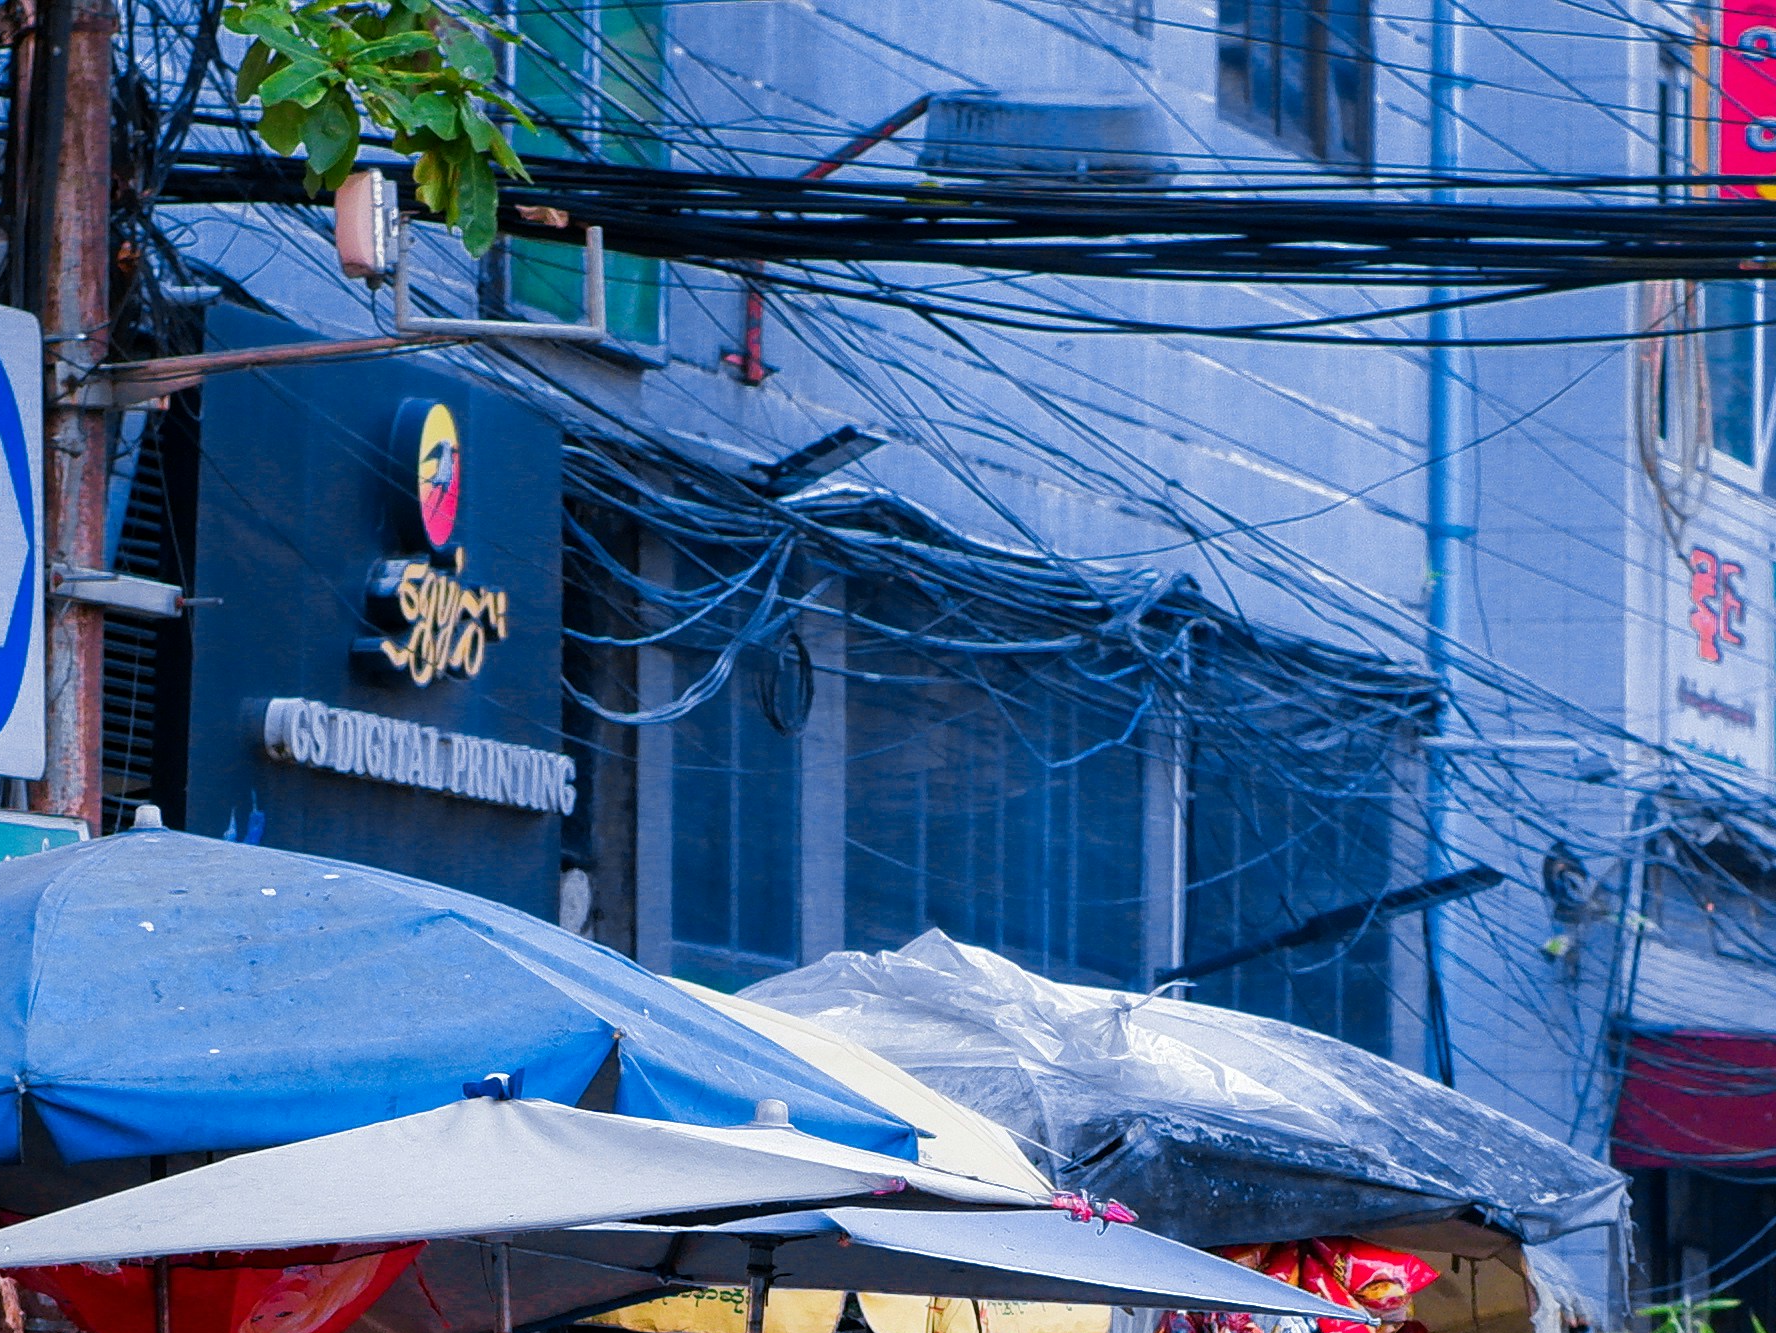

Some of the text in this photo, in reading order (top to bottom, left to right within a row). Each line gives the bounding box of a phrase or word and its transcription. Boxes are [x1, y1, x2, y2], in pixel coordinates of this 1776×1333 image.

[282, 698, 578, 817] GS DIGITAL PRINTING
